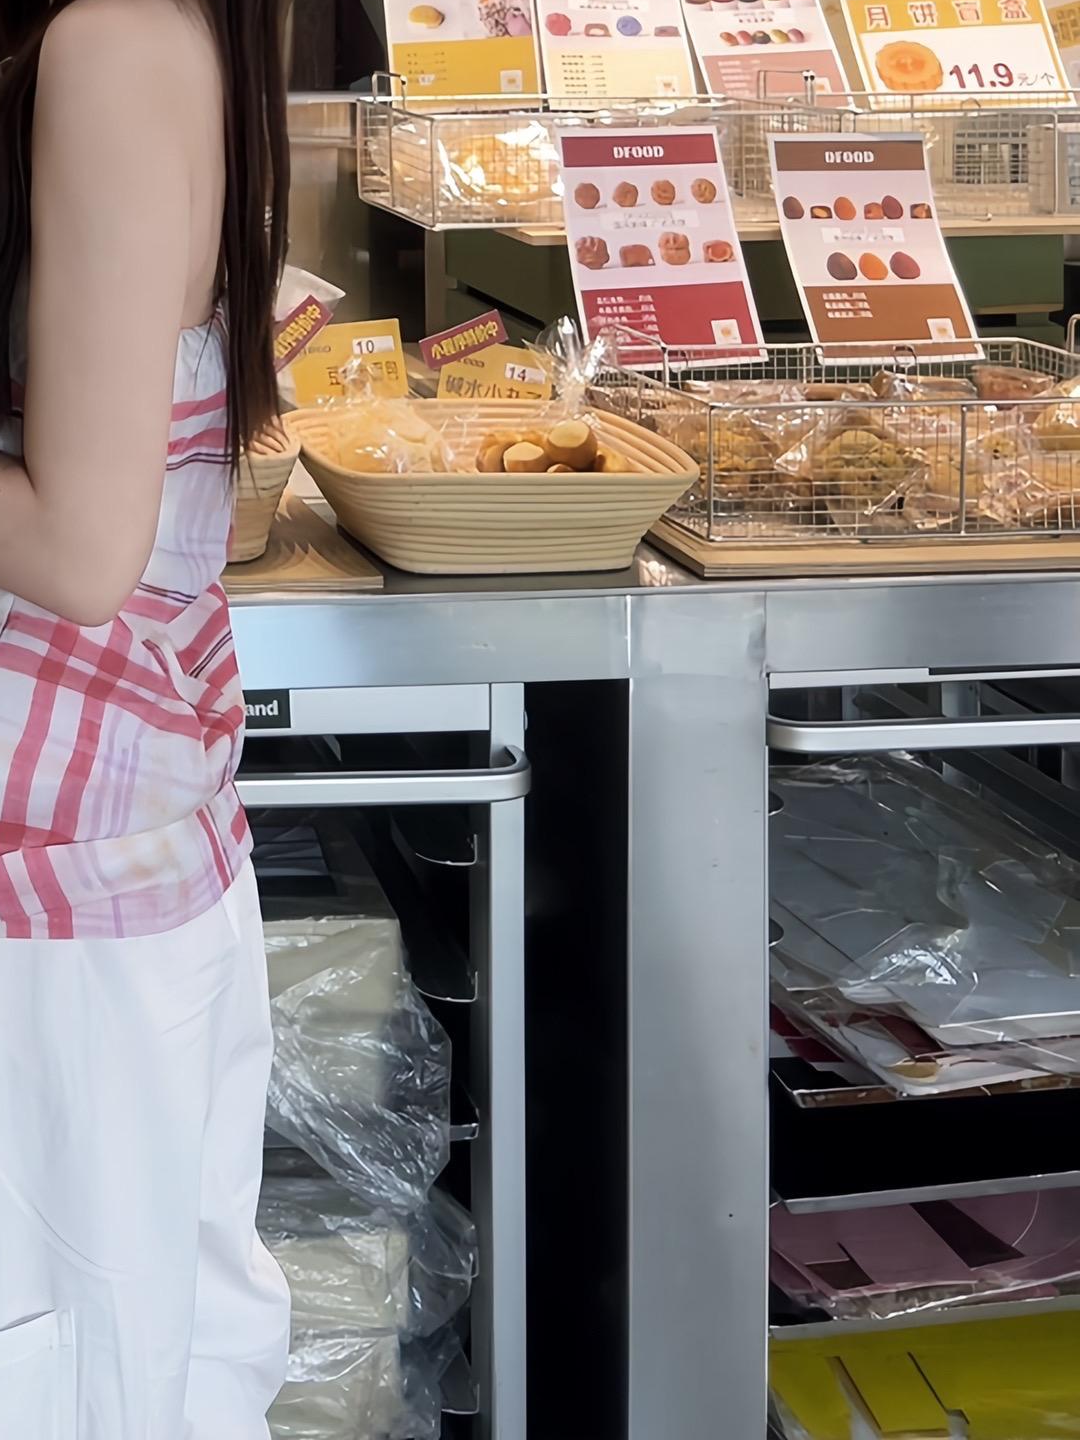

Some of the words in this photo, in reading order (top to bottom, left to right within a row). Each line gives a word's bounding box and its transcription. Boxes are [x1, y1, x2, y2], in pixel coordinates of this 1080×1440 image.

[948, 62, 1015, 91] 11.9
[356, 340, 375, 355] 10
[509, 366, 527, 382] 14
[244, 699, 279, 717] and
